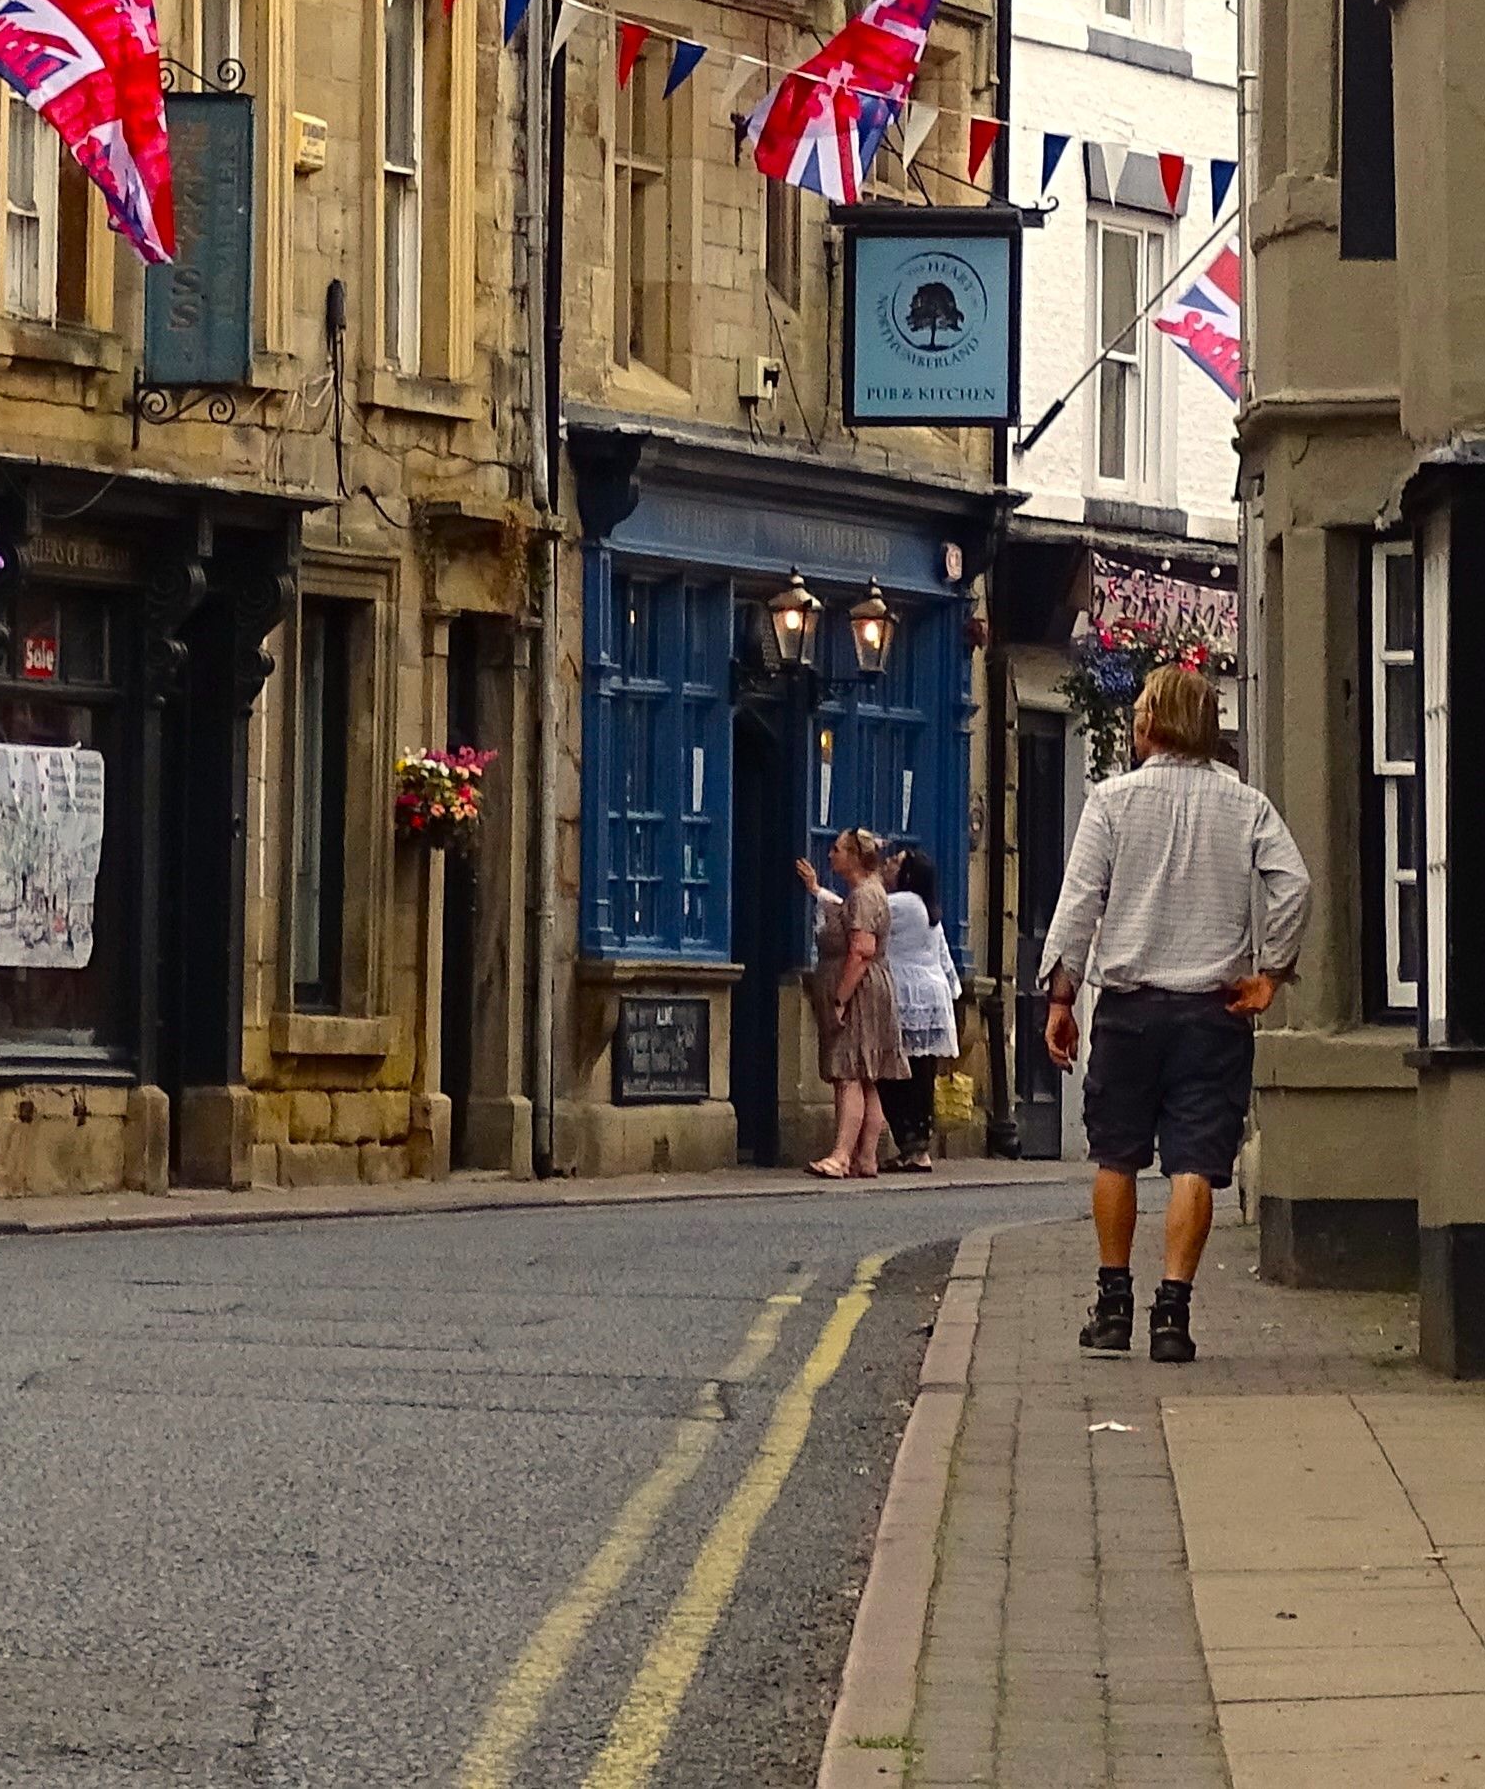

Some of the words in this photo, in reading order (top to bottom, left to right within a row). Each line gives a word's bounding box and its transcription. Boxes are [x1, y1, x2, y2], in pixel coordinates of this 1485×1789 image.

[867, 387, 898, 401] PUB
[902, 387, 913, 400] &
[919, 387, 996, 401] KITCHEN
[26, 639, 54, 671] Sale
